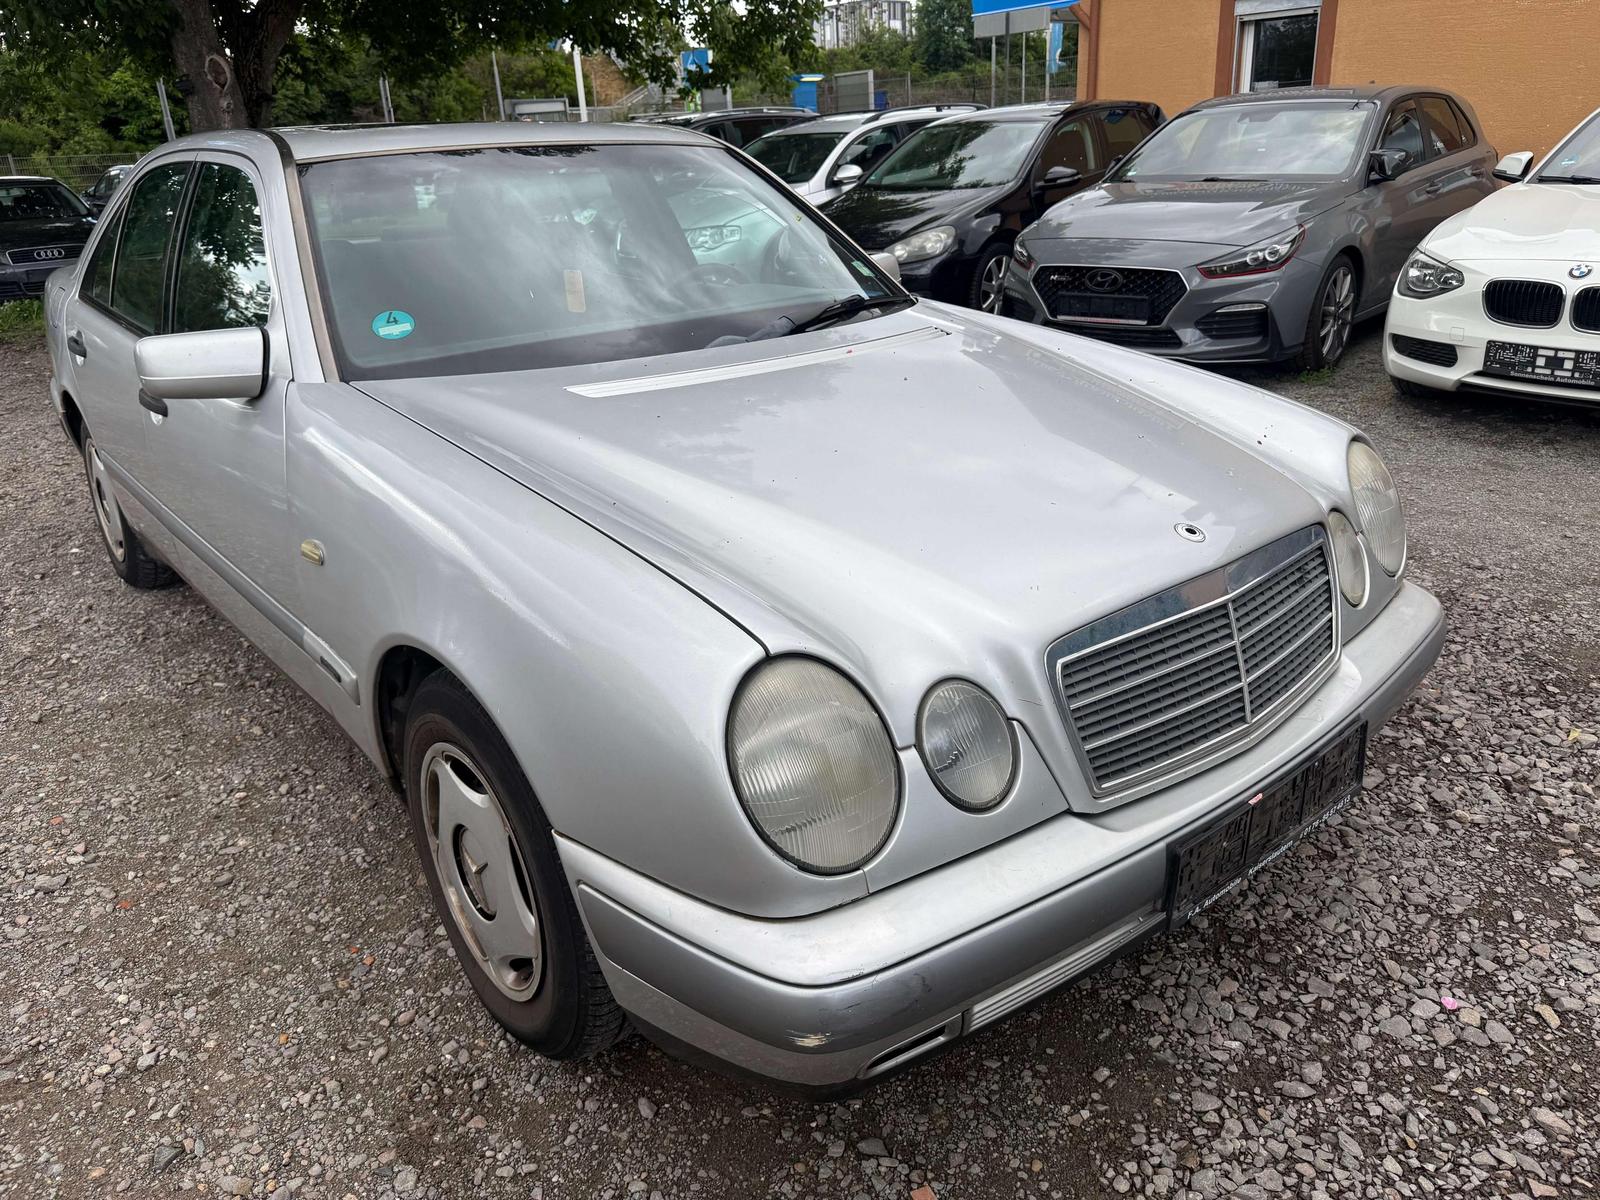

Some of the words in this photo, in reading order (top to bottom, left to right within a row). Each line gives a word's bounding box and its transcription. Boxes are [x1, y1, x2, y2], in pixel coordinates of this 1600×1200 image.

[386, 311, 398, 325] 4
[1510, 370, 1555, 382] Sonnenschein
[1555, 376, 1596, 386] Automobile
[1203, 877, 1242, 908] Automobile
